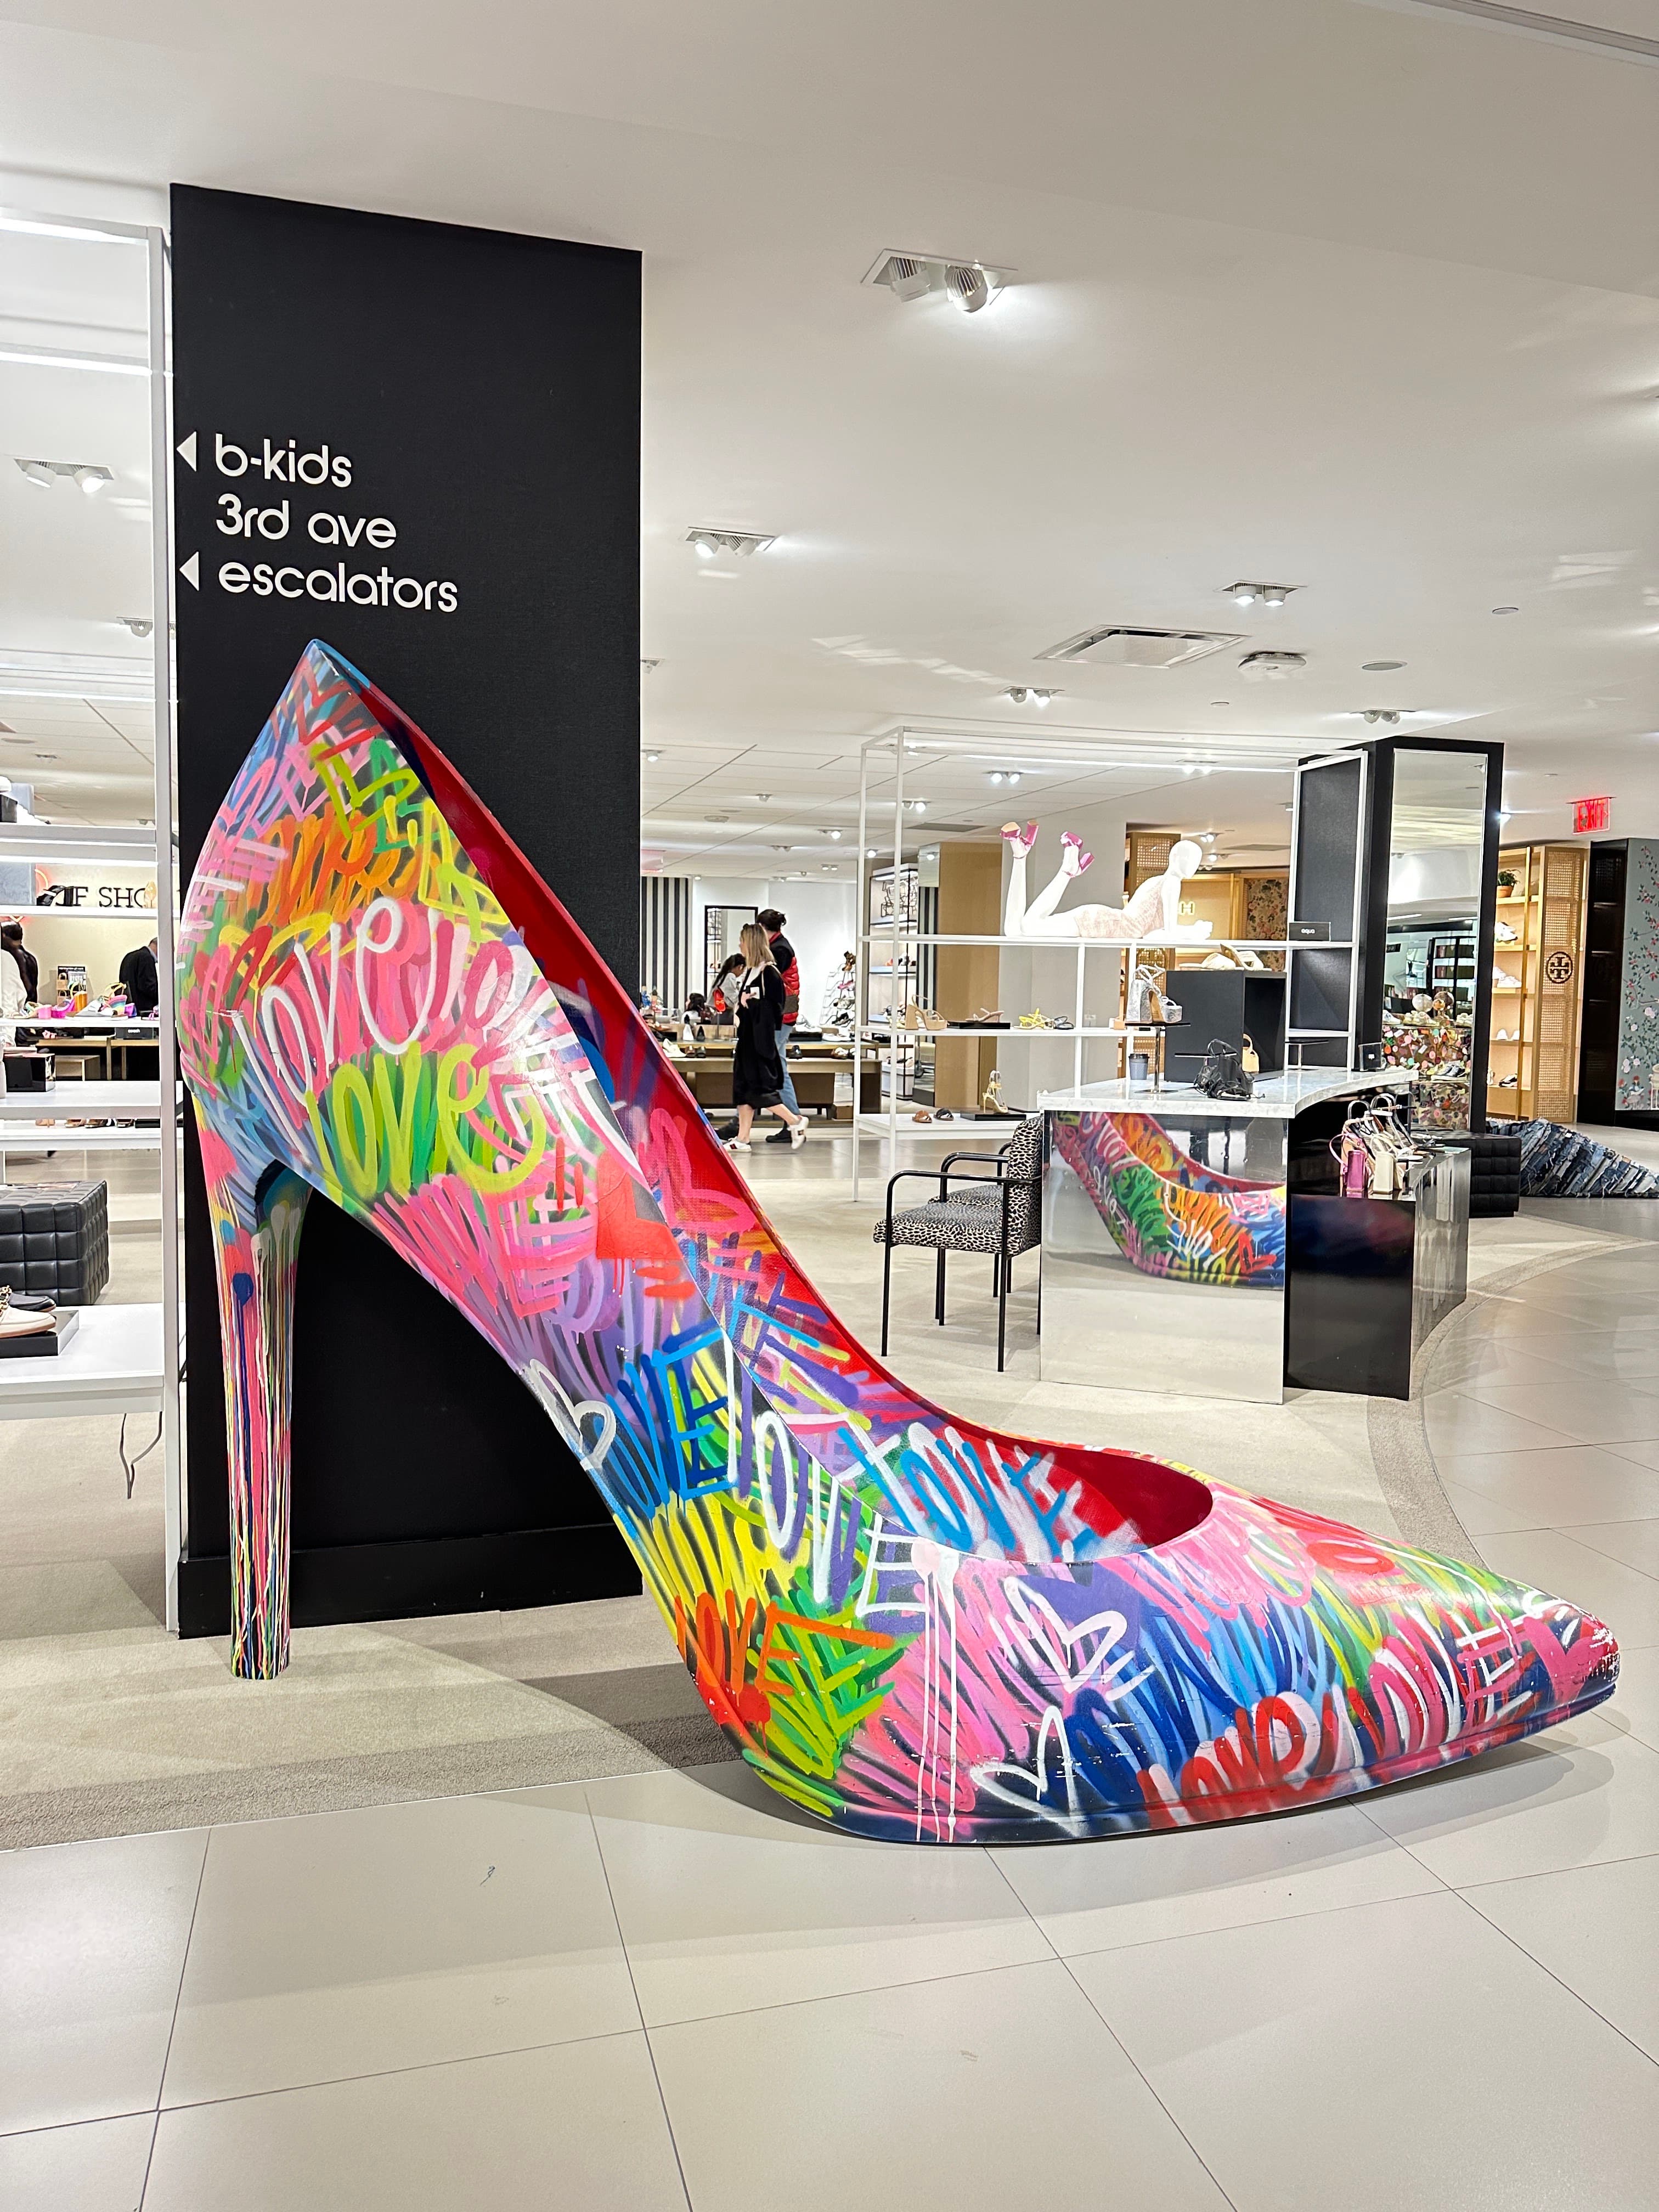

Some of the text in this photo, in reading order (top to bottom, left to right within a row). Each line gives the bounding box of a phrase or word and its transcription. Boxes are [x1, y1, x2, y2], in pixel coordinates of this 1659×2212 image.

[215, 433, 352, 488] b-kids
[216, 493, 397, 549] 3rd ave
[218, 562, 458, 613] escalators
[1577, 799, 1605, 831] EXIT
